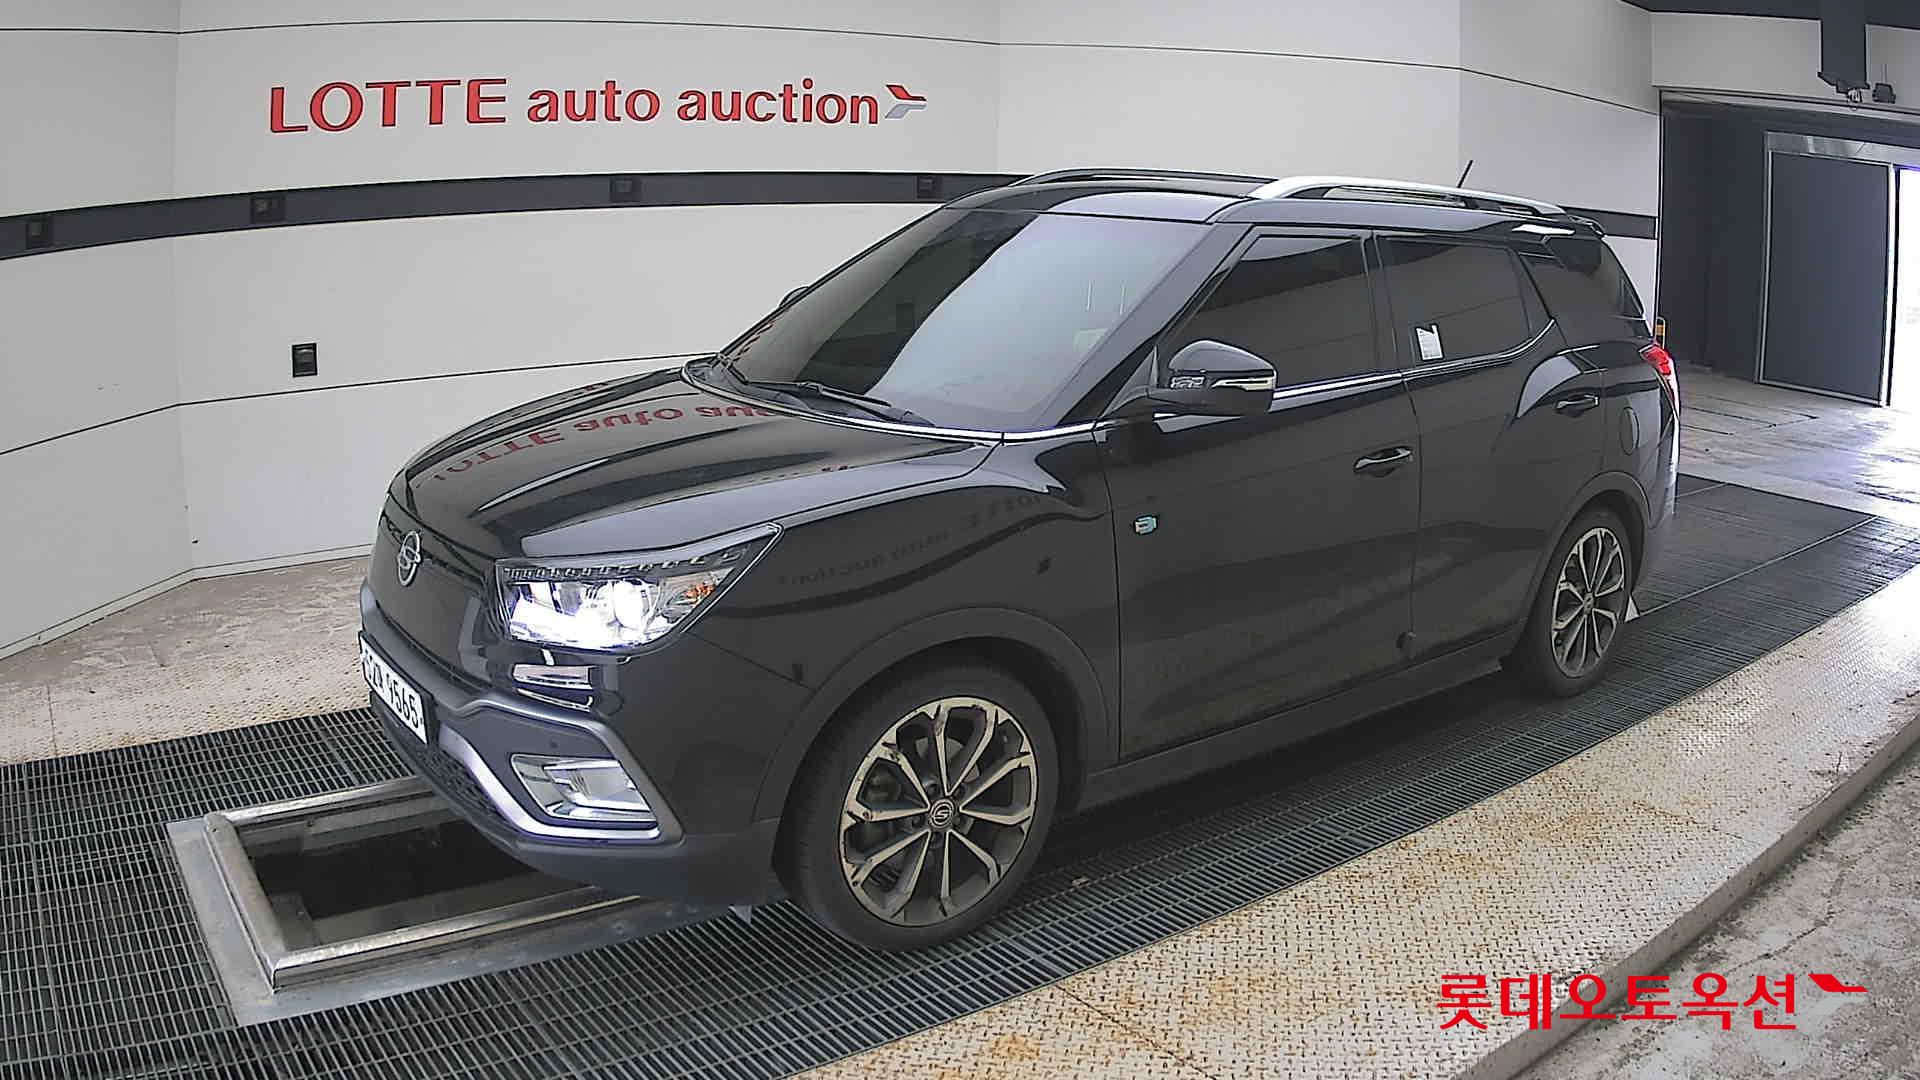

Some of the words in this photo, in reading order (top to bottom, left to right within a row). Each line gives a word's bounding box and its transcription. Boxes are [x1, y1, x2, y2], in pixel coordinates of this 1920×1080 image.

[270, 78, 506, 133] LOTTE
[527, 80, 661, 123] auto
[677, 79, 878, 124] auction
